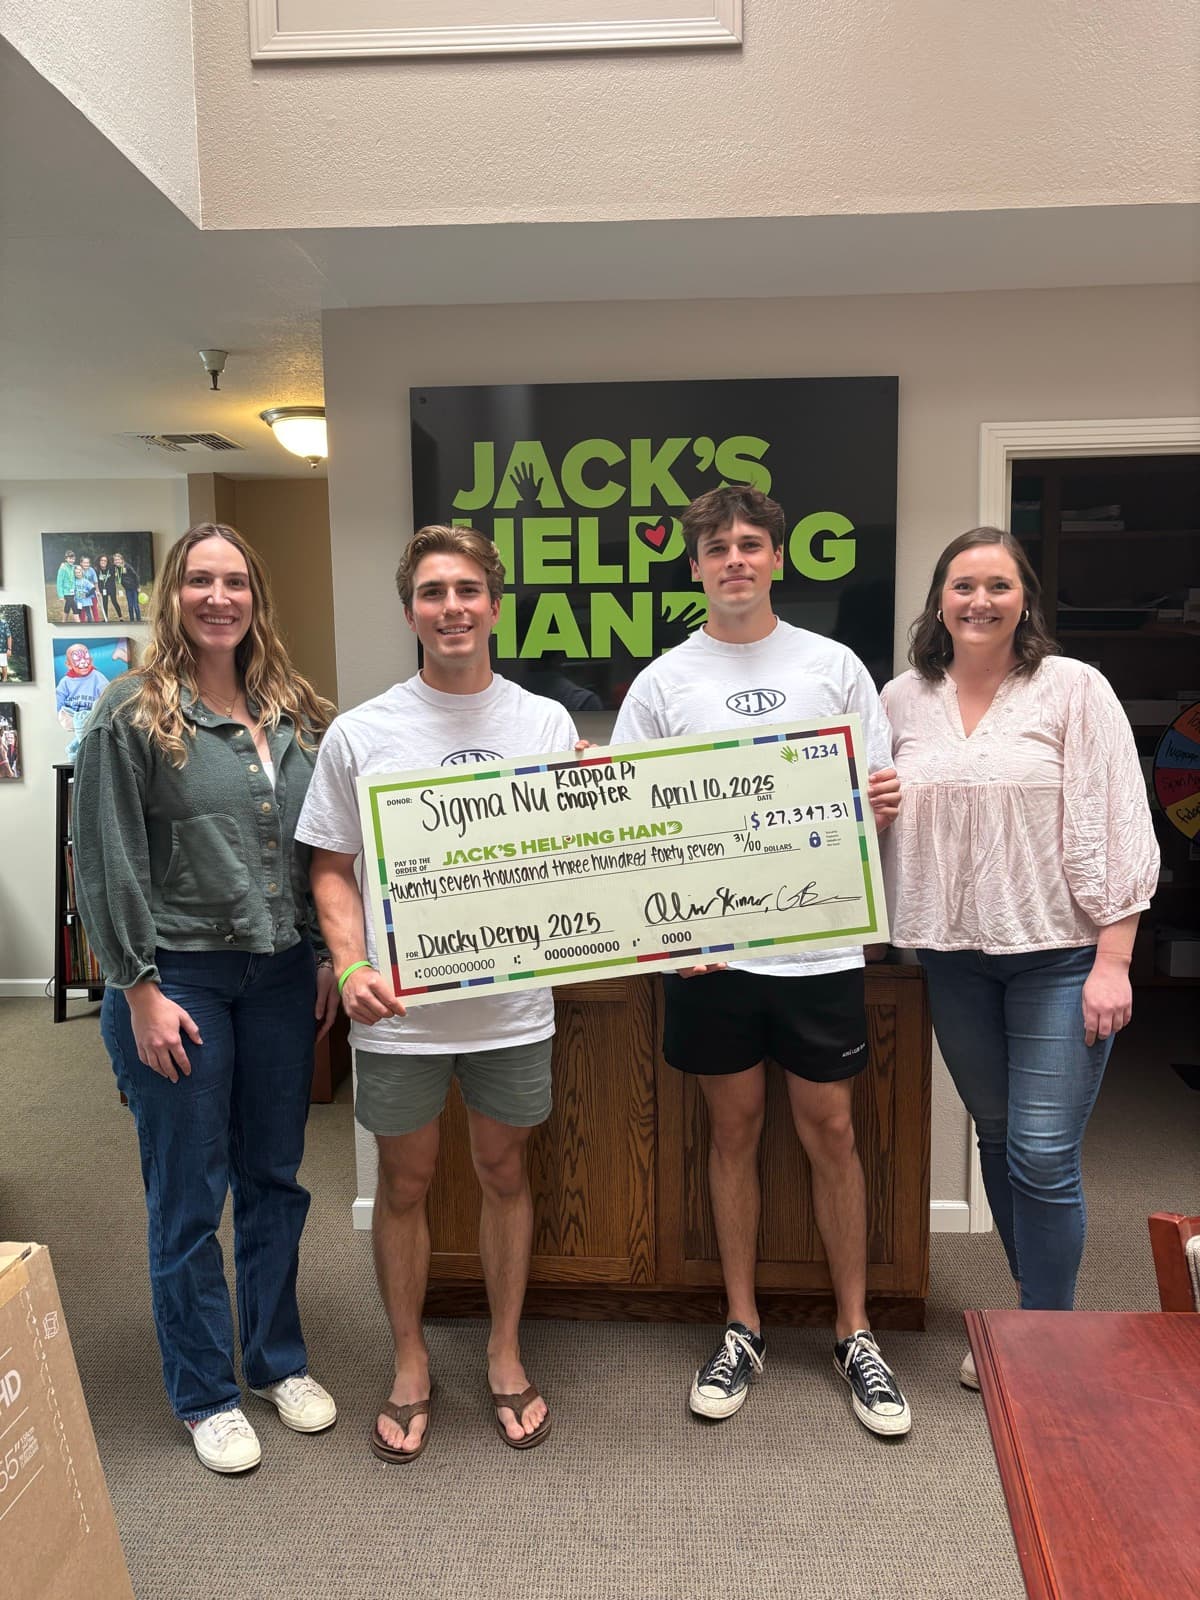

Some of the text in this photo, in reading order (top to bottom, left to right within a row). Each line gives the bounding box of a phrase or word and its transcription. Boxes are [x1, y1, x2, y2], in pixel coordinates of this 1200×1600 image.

[452, 436, 772, 511] JACK'S
[452, 511, 856, 585] ELPG
[802, 744, 839, 760] 1234
[555, 761, 636, 790] Kappa Pi
[386, 797, 413, 807] DONOR:
[651, 780, 697, 809] April
[757, 794, 773, 802] DATE
[420, 781, 550, 838] Sigma Nu
[751, 811, 761, 831] $
[442, 820, 684, 866] JACK'S HELPING HAND
[763, 843, 793, 853] DOLLARS
[389, 877, 438, 903] twenty
[439, 873, 482, 894] seven
[483, 861, 549, 888] thousand
[687, 842, 725, 861] seven
[394, 860, 407, 868] PAY
[419, 857, 431, 865] THE
[395, 866, 418, 875] ORDER
[418, 911, 601, 959] Ducky Derby 2025
[661, 931, 693, 945] 0000
[405, 951, 419, 959] FOR
